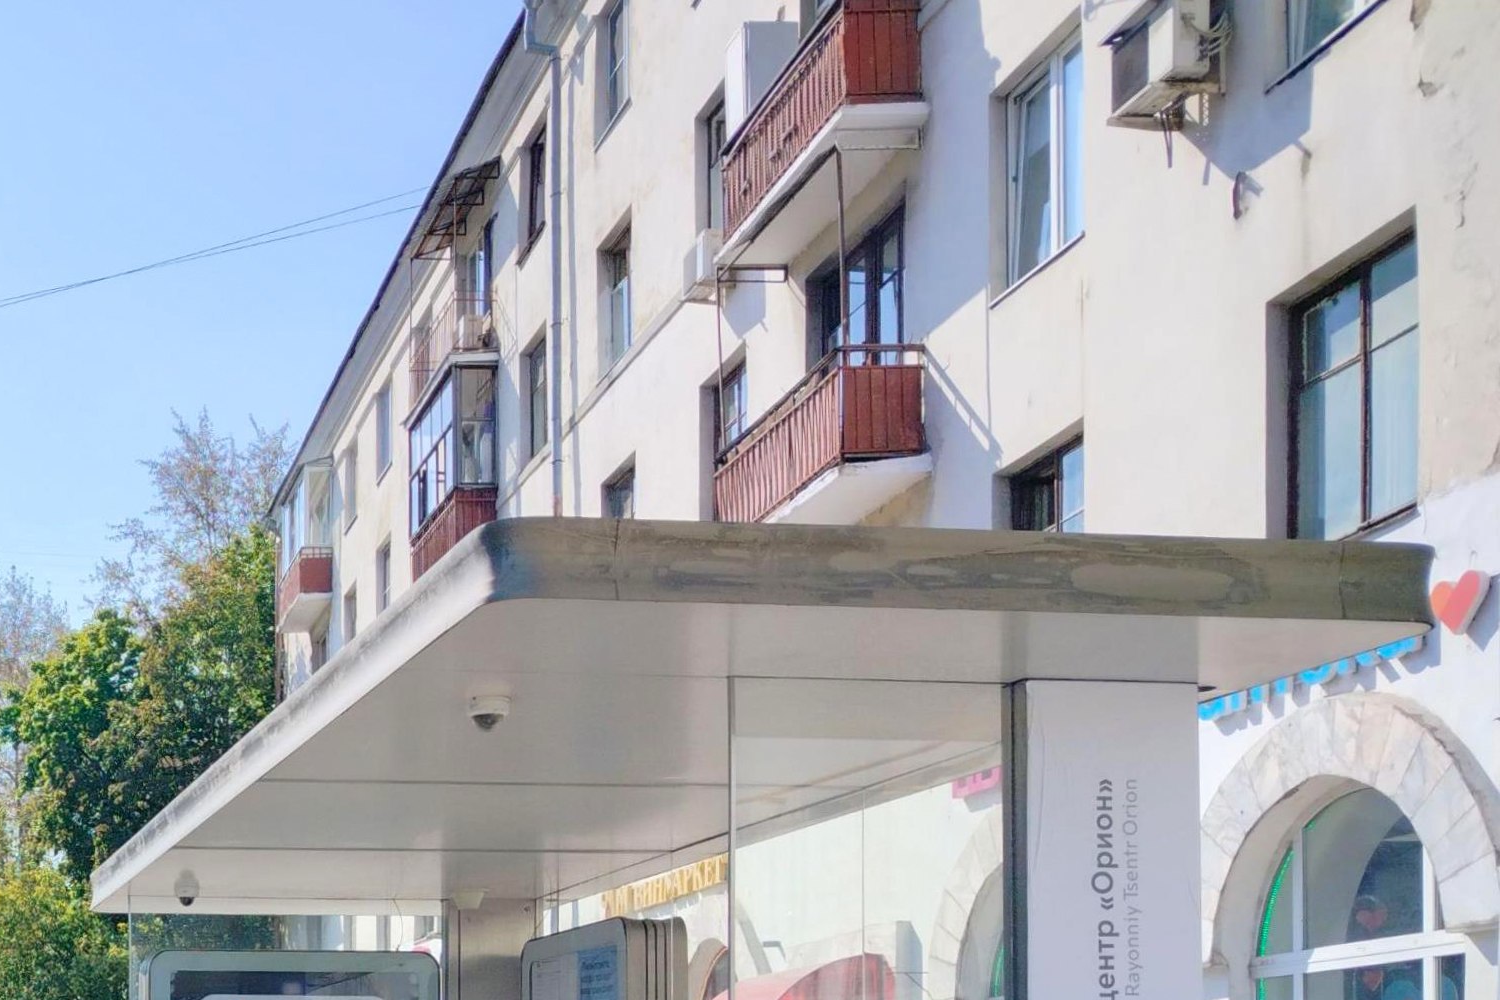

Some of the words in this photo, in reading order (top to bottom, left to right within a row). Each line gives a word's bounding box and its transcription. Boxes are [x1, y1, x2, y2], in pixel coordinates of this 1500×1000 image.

[1091, 778, 1119, 910] «Орион»
[1122, 779, 1138, 836] Orion
[1122, 842, 1139, 899] Tsentr
[1124, 906, 1143, 997] Rayonniy
